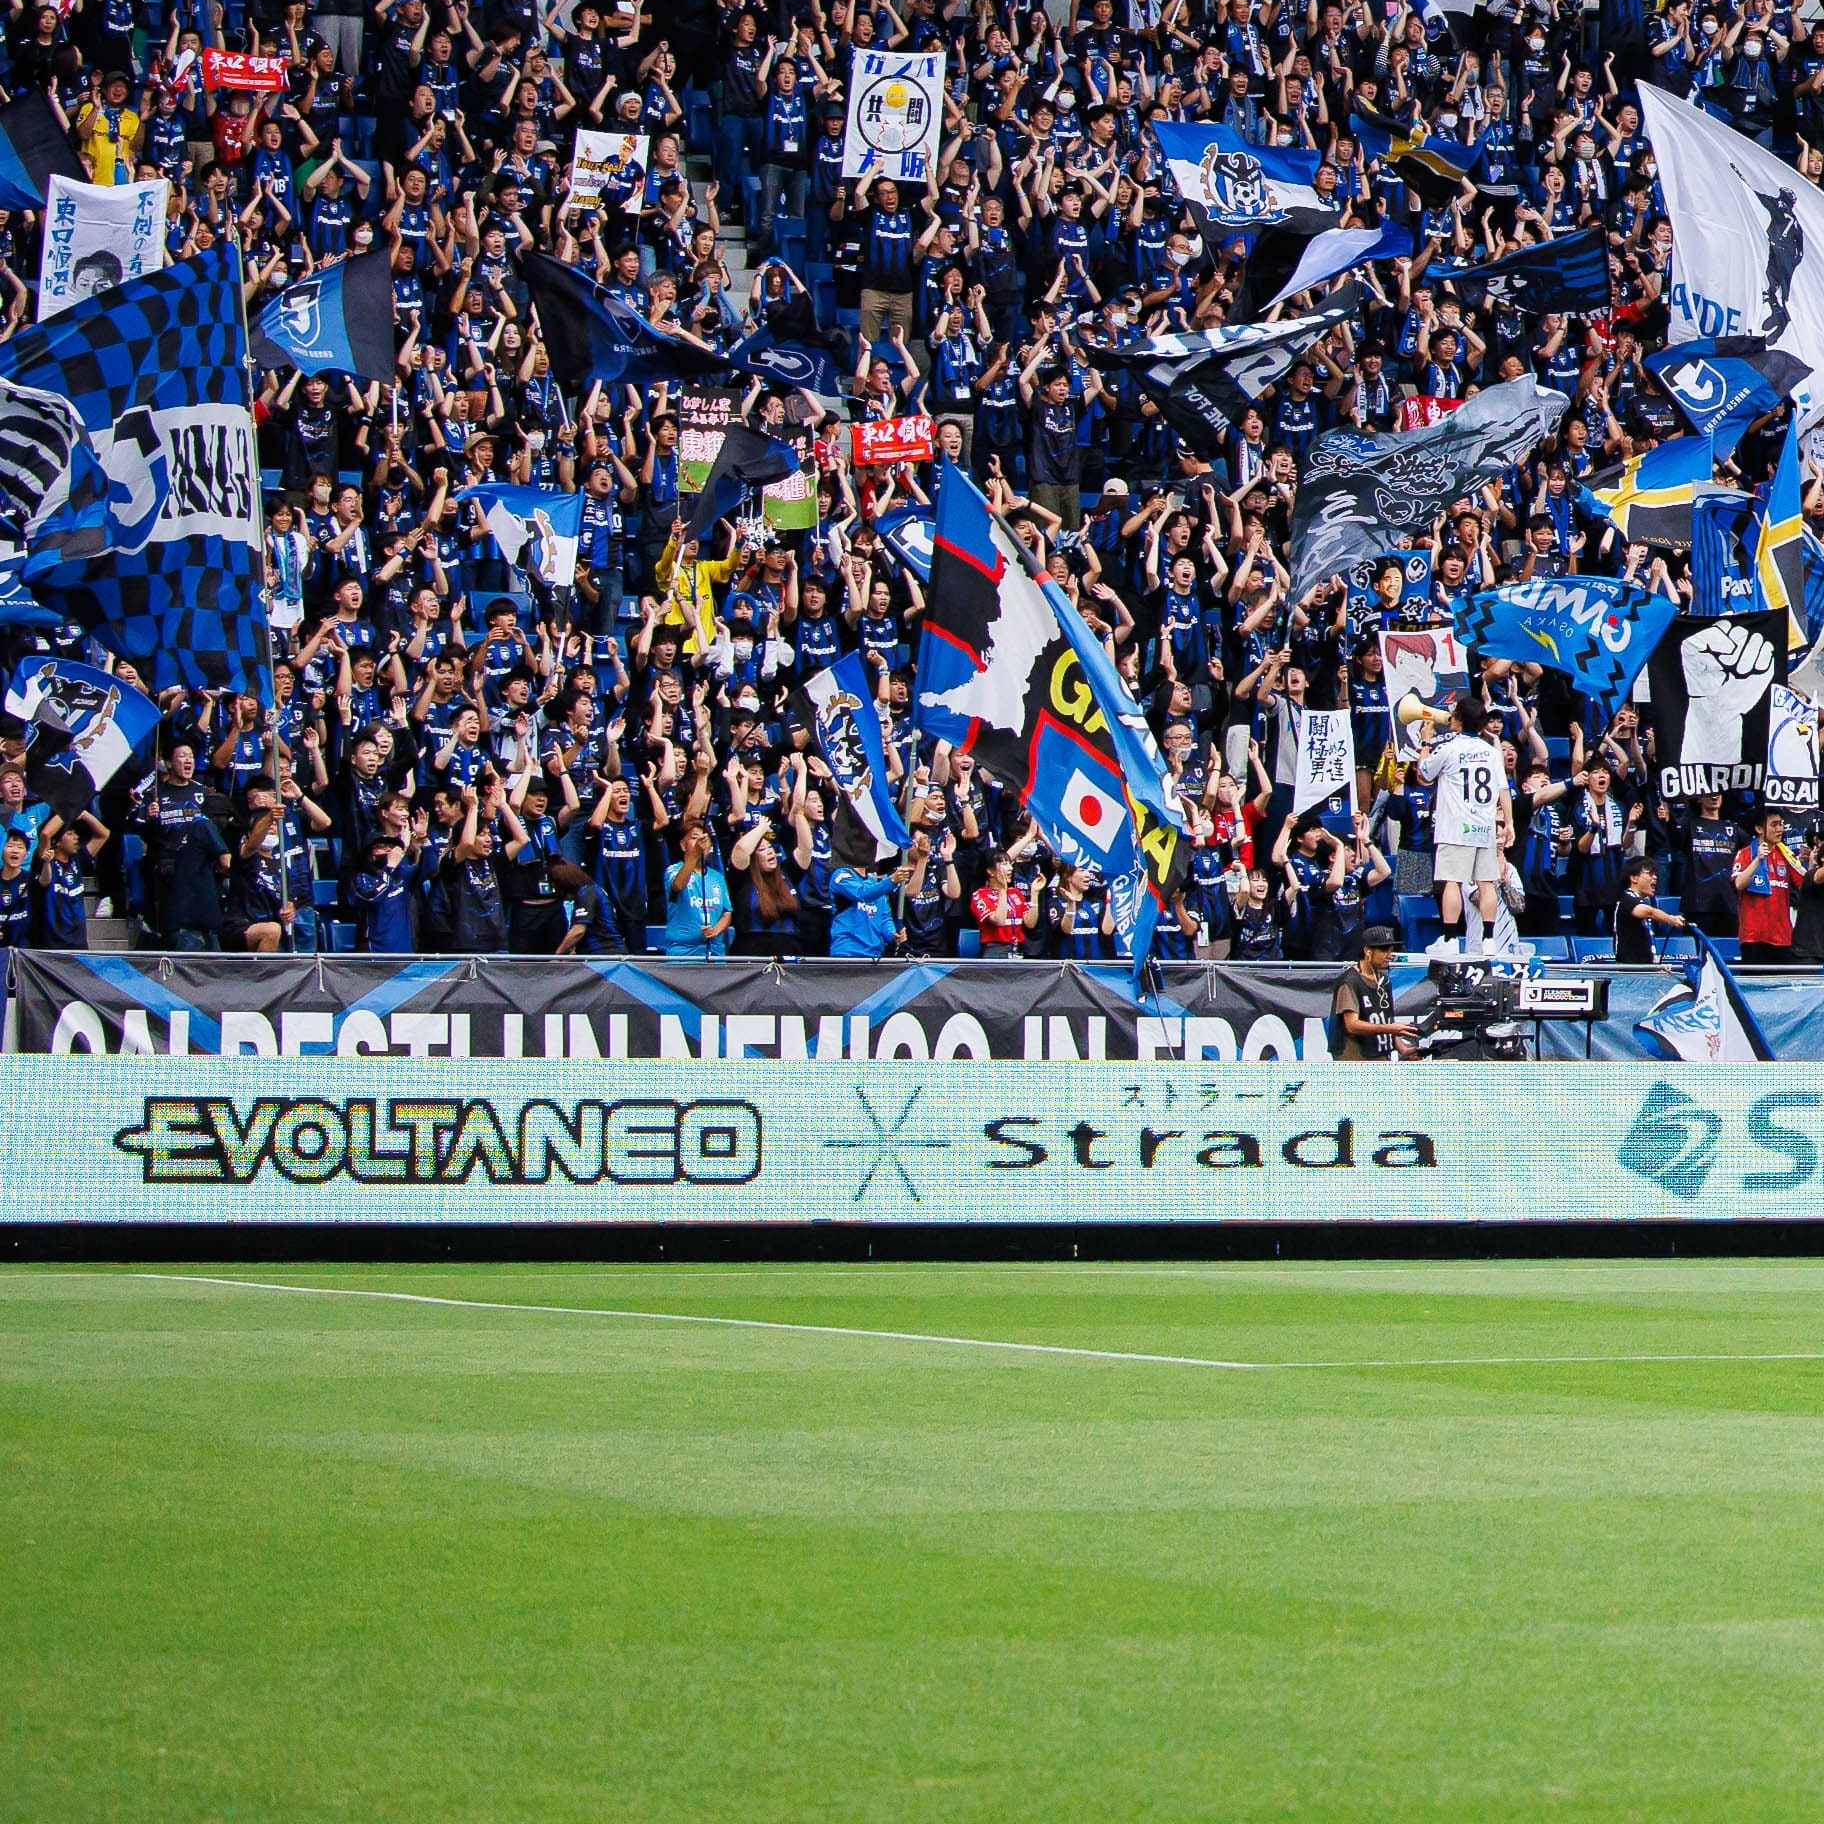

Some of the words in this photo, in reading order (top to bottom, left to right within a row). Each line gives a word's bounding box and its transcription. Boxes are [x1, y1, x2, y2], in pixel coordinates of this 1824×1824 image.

[864, 55, 937, 78] ガンバ
[1459, 765, 1495, 805] 18
[1471, 824, 1492, 834] SHIP
[983, 1112, 1437, 1170] Strada
